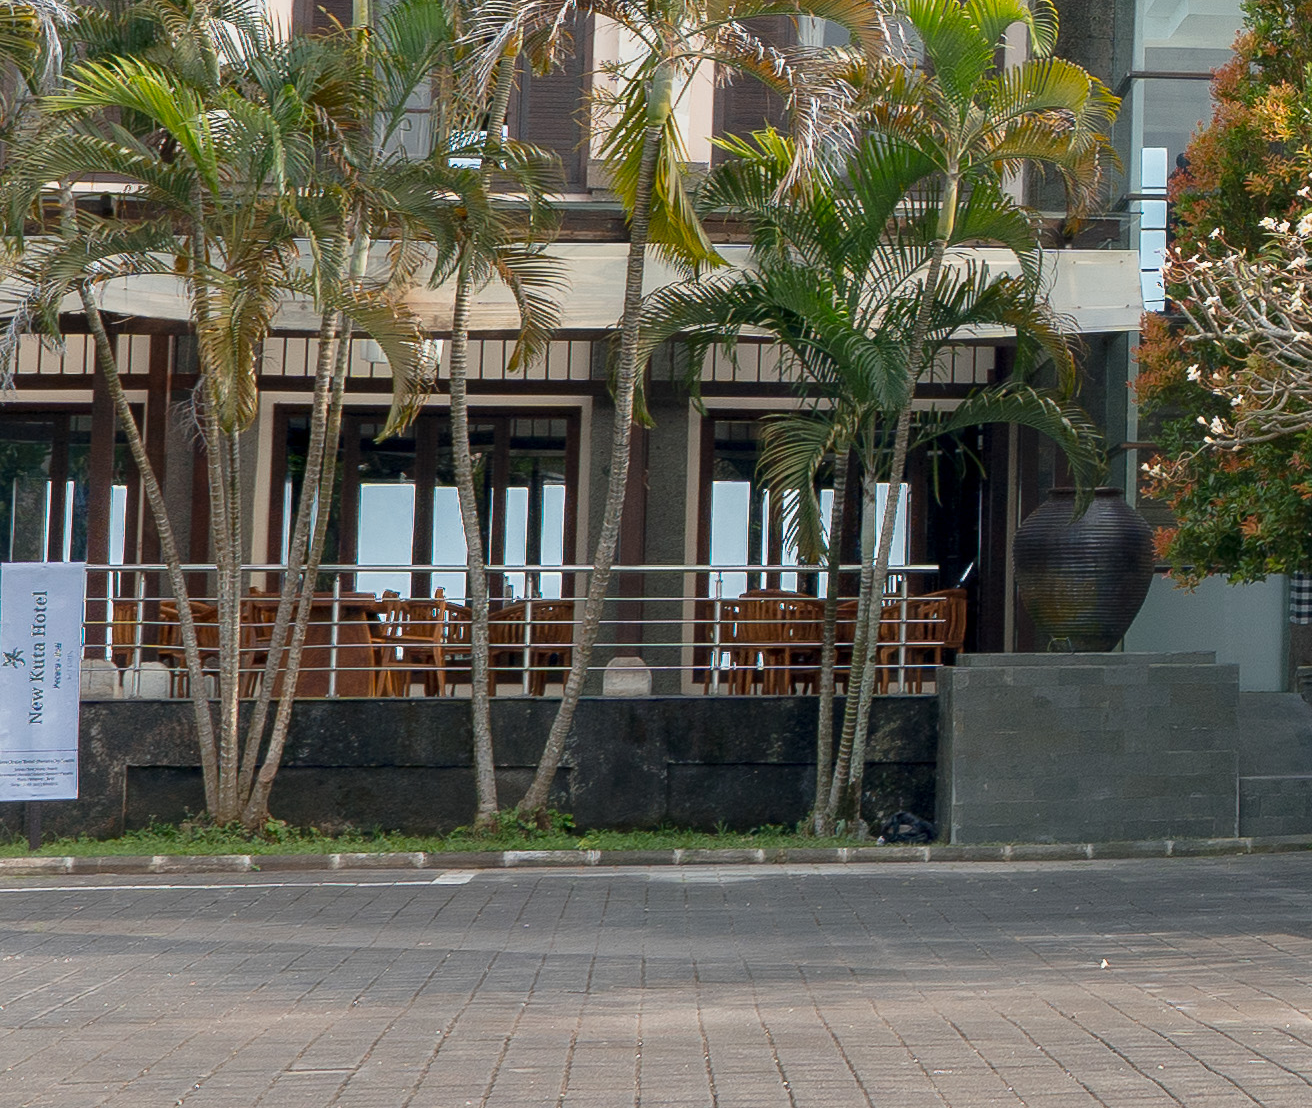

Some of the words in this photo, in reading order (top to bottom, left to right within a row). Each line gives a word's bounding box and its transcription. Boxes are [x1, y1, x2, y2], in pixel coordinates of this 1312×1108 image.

[31, 591, 47, 637] Hotel
[29, 642, 45, 683] Kuta
[28, 687, 43, 725] New
